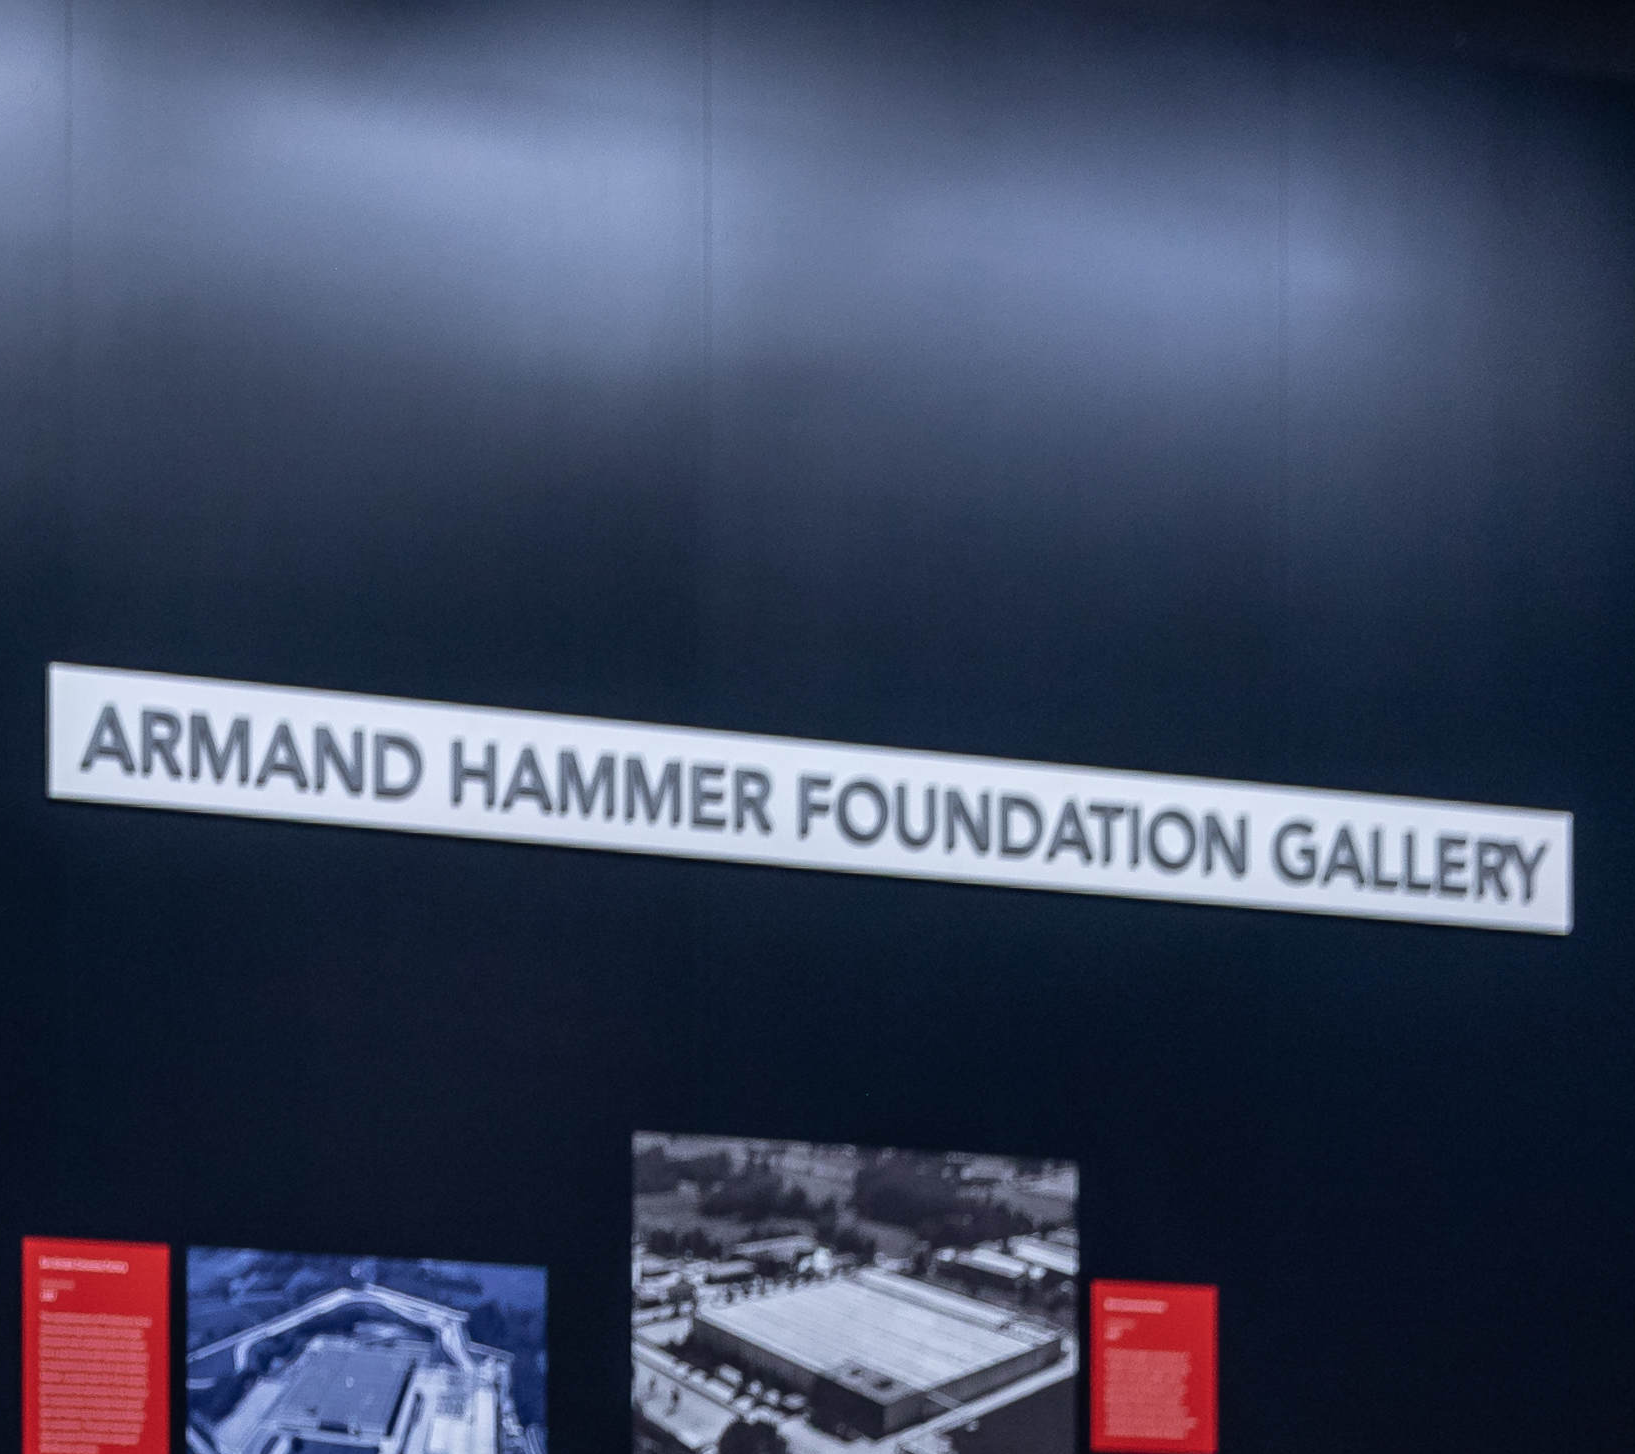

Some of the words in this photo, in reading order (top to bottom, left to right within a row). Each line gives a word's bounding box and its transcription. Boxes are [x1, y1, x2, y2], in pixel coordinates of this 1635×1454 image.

[80, 702, 425, 801] ARMAND
[448, 736, 774, 834] HAMMER
[796, 769, 1250, 878] FOUNDATION
[1274, 818, 1550, 906] GALLERY
